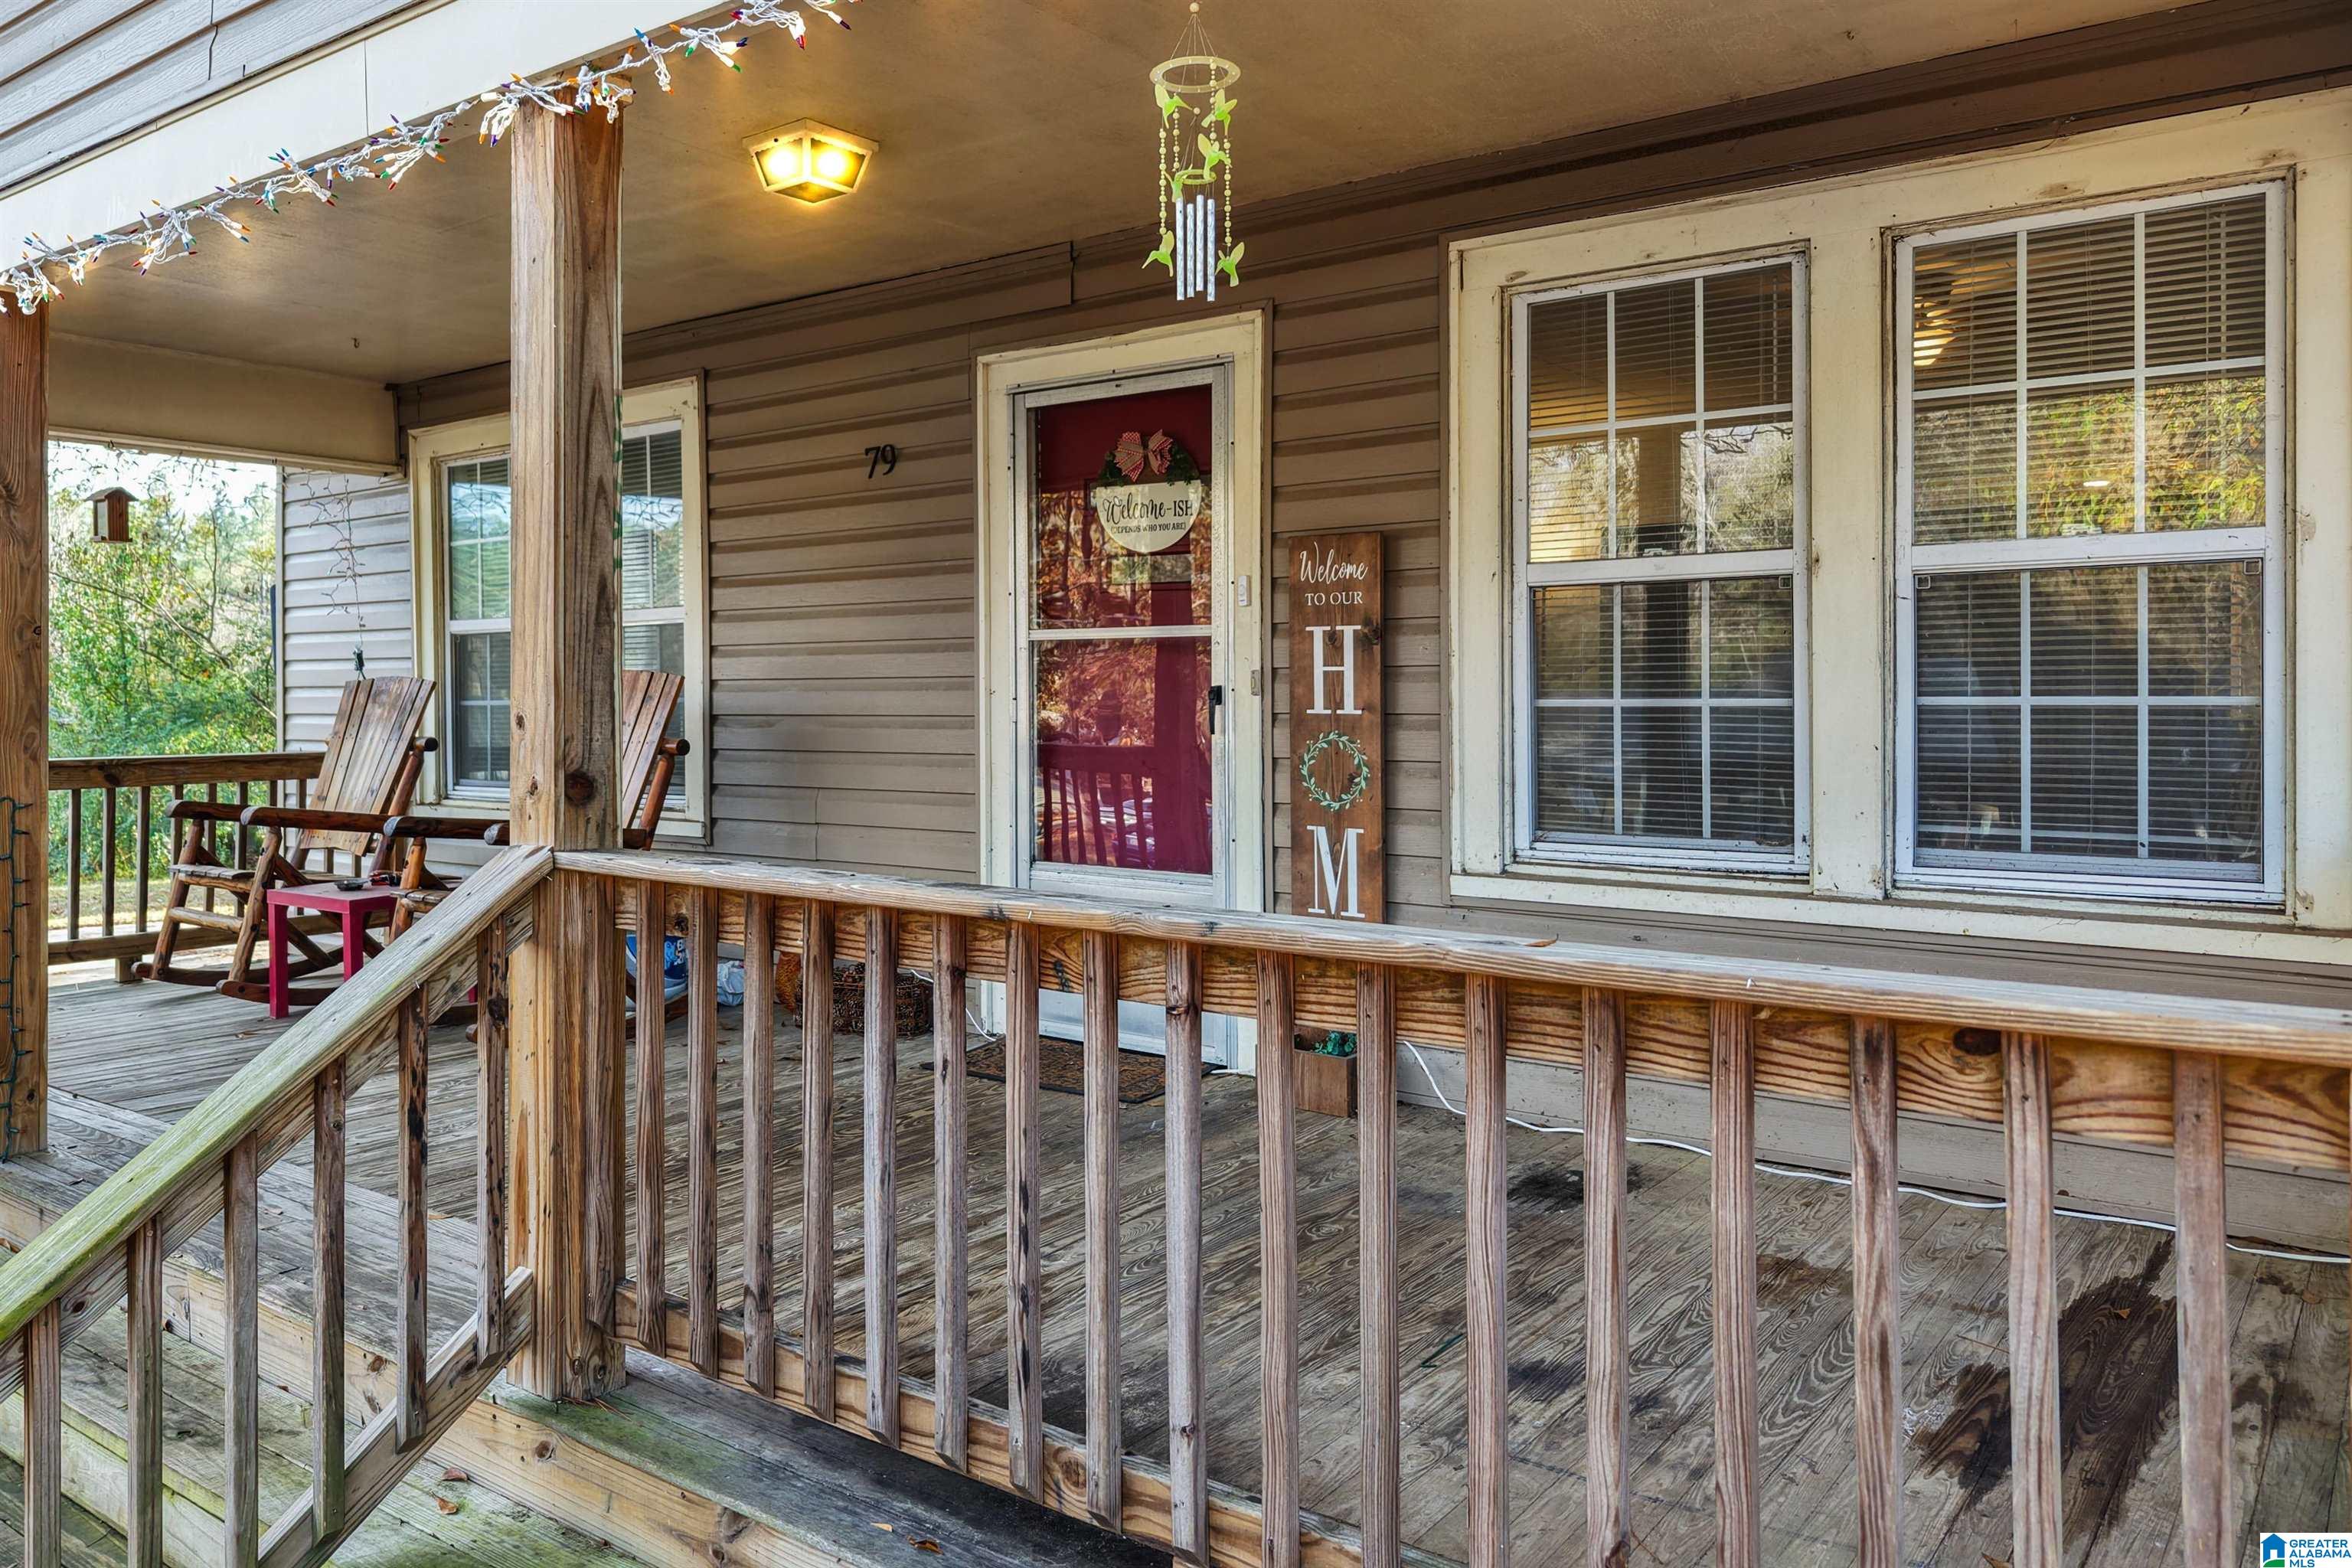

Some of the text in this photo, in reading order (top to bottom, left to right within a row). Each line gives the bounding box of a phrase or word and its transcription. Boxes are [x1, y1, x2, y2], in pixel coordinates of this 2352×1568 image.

[864, 444, 897, 479] 79
[1102, 492, 1194, 524] Welcome-ISH
[1143, 524, 1158, 532] WHO
[1158, 523, 1171, 531] YOU
[1300, 541, 1368, 584] Welcome
[1305, 591, 1363, 606] TO OUR
